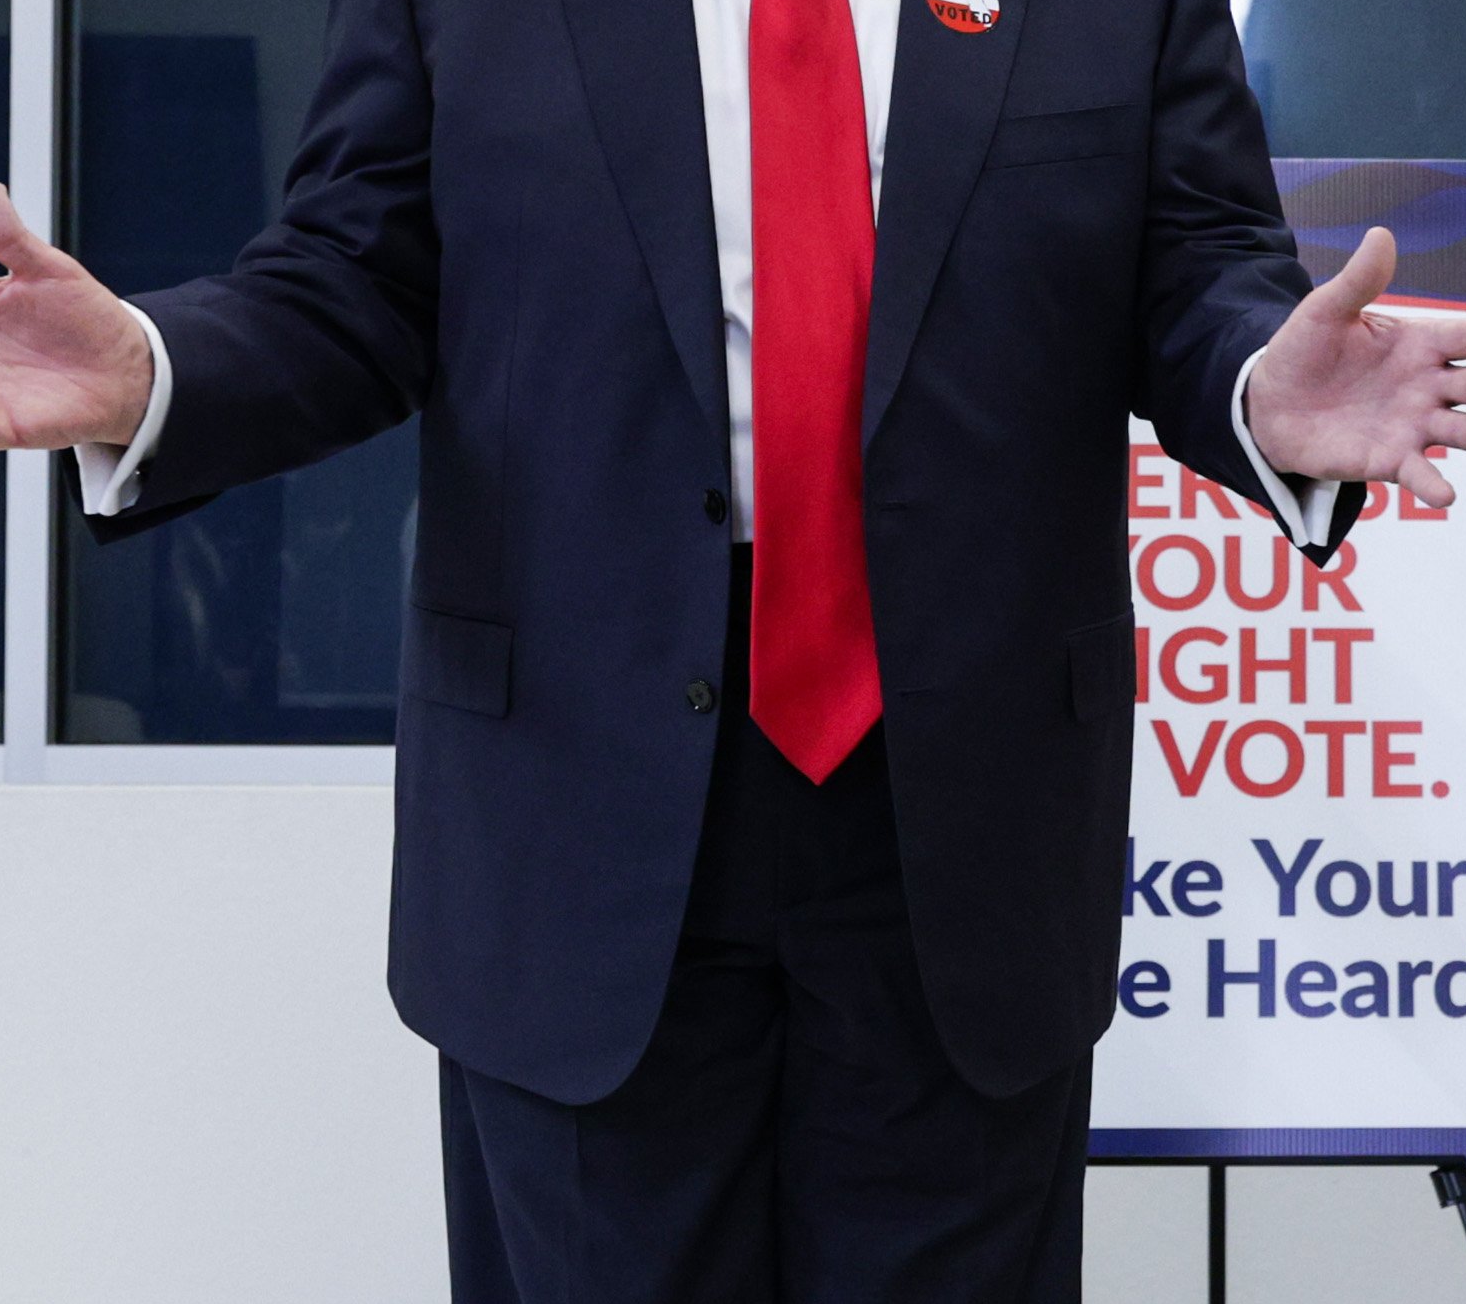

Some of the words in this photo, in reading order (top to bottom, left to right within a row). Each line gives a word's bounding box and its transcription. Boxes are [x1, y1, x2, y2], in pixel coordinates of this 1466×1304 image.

[934, 3, 992, 25] VOTED
[1128, 533, 1365, 613] OUR
[1134, 625, 1376, 706] IGHT
[1150, 718, 1451, 799] VOTE.
[1122, 836, 1224, 918] ke
